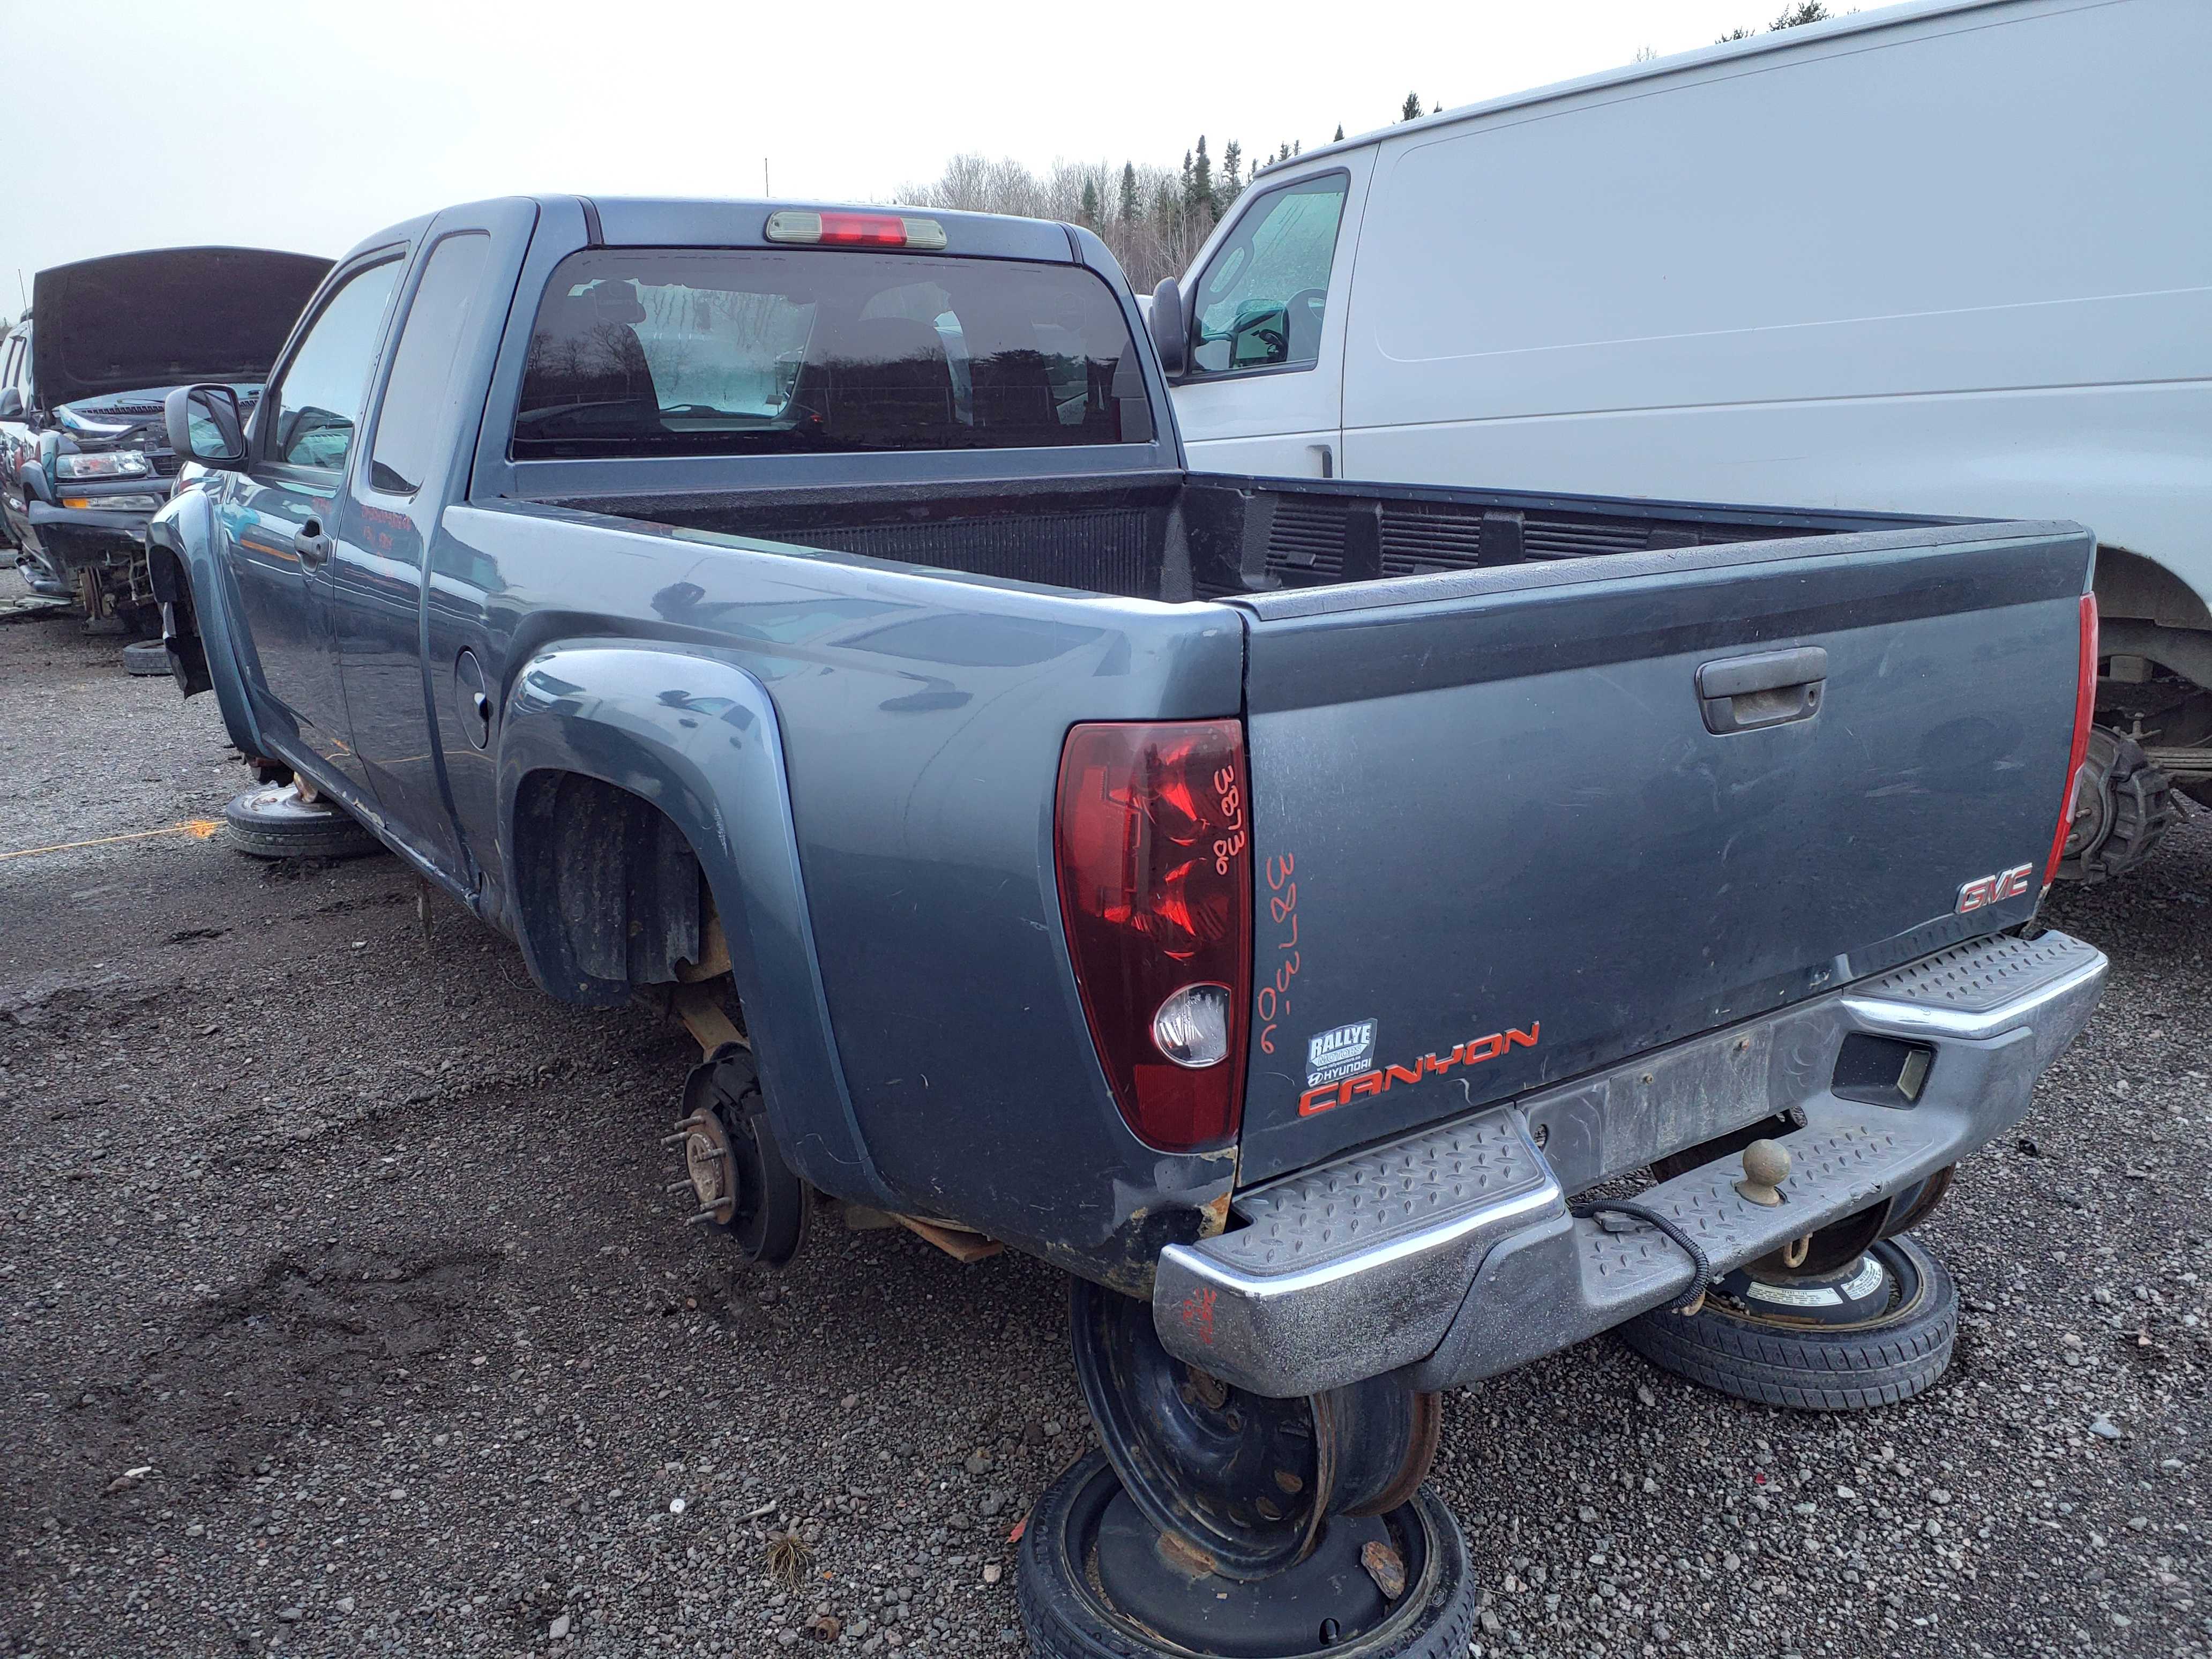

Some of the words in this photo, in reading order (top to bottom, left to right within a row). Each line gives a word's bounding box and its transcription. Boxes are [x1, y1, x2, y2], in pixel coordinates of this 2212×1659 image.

[1955, 862, 2033, 914] GMC
[1311, 1023, 1372, 1060] RALLYE
[1317, 1046, 1363, 1066] MOTORS
[1297, 1020, 1540, 1118] CANYON
[1324, 1058, 1372, 1081] HYUNDAI
